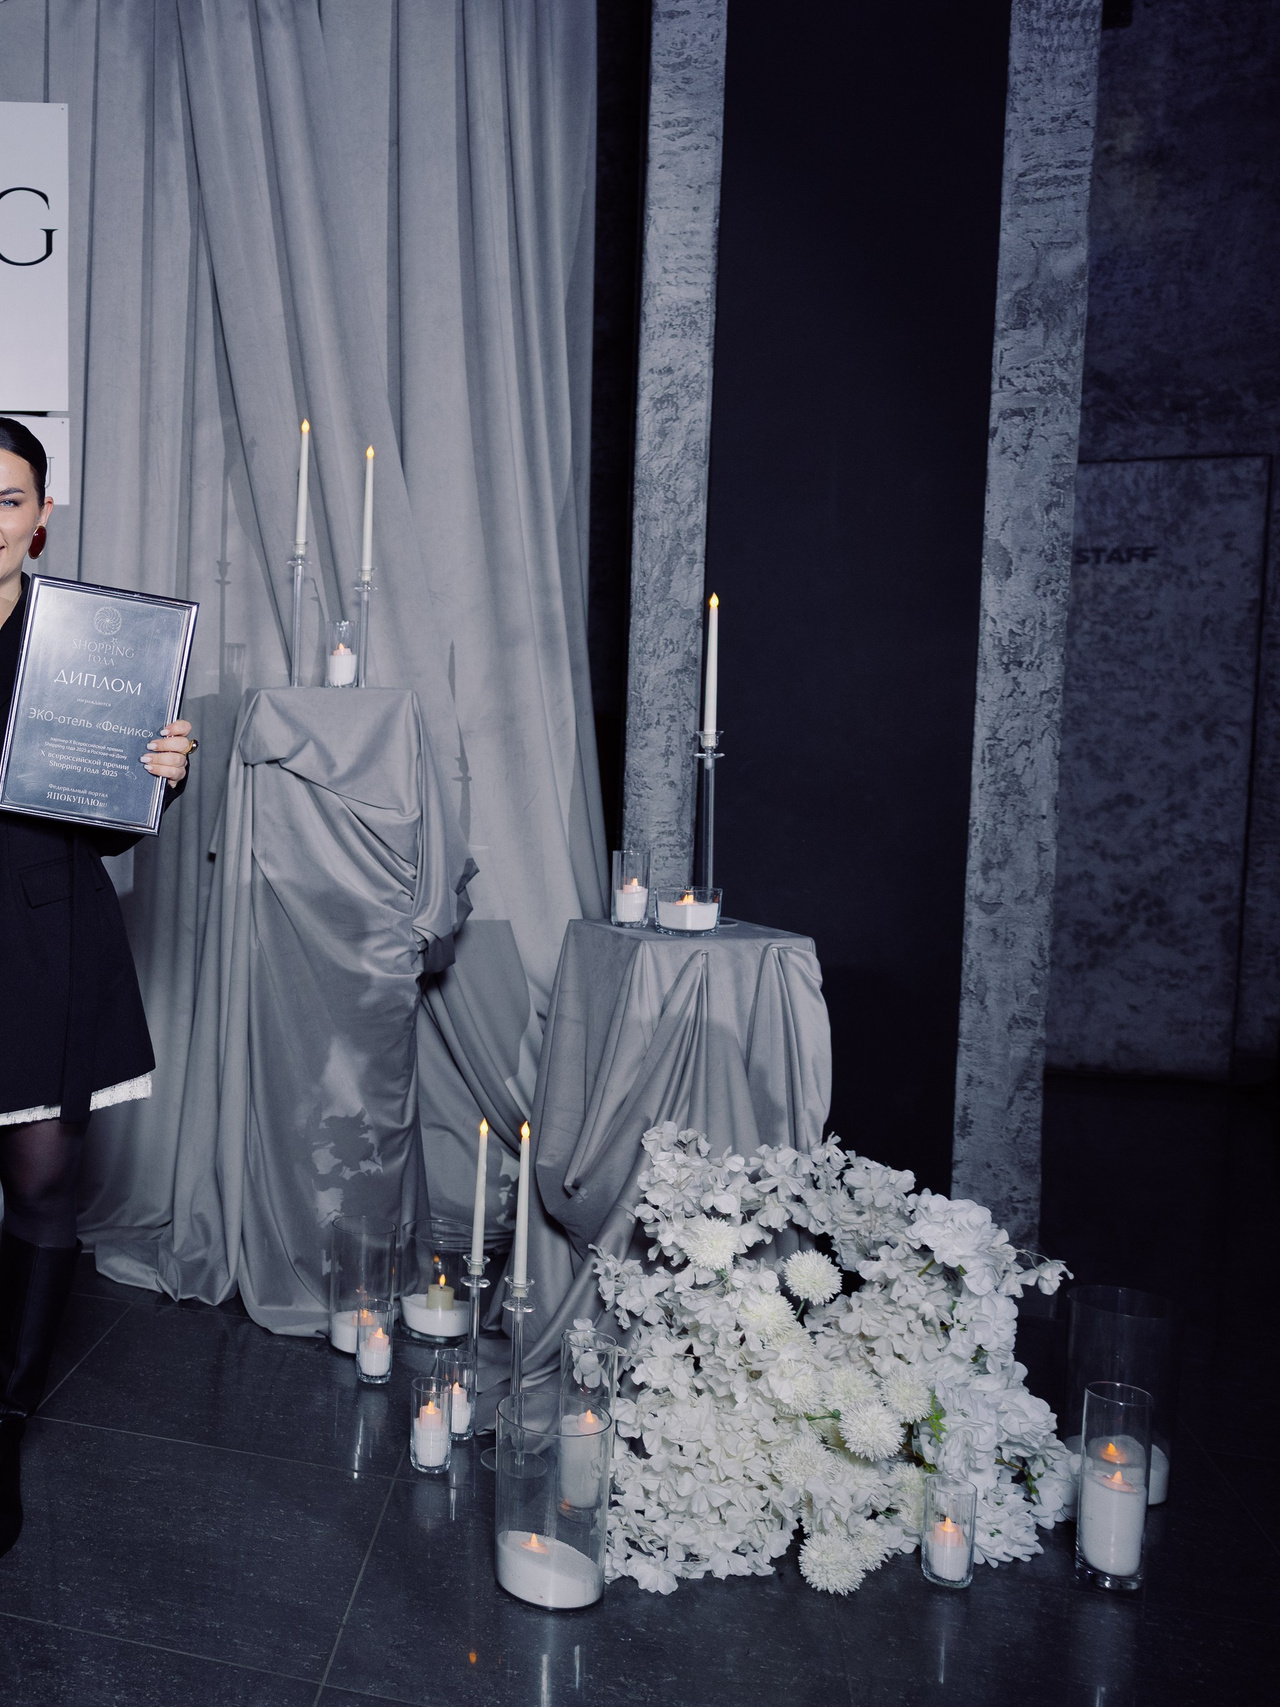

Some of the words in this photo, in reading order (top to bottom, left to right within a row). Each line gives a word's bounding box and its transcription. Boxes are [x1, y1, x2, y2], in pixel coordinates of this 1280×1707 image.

[1073, 545, 1158, 565] STAFF
[71, 638, 135, 659] SHOPPING
[87, 653, 116, 666] ГОДА
[53, 669, 142, 696] ДИПЛОМ
[27, 707, 93, 729] ЭКО-отель
[95, 720, 154, 738] «Феникс»
[47, 752, 101, 766] всероссийской
[102, 761, 130, 771] премии
[49, 759, 82, 773] Shopping
[83, 767, 100, 775] года
[101, 768, 118, 778] 2025
